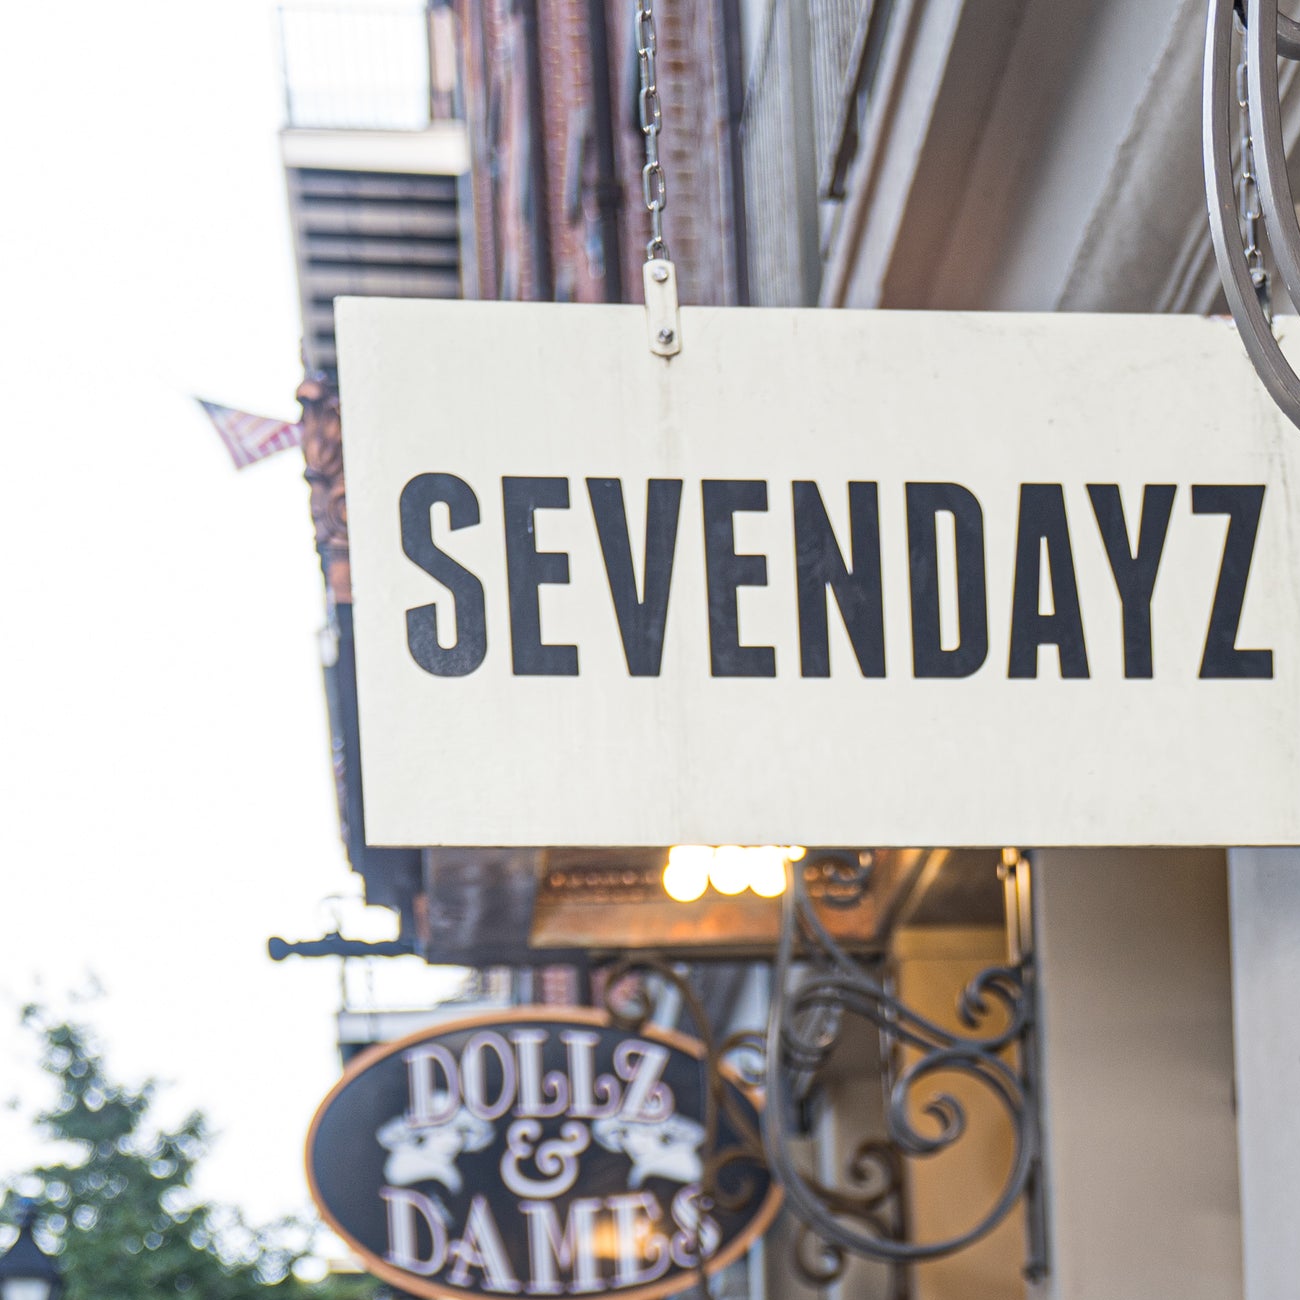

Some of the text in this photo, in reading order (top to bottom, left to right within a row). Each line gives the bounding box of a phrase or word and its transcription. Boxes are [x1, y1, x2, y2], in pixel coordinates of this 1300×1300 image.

[398, 470, 1275, 681] SEVENDAYZ
[404, 1028, 676, 1129] DOLLZ
[500, 1118, 591, 1199] &
[379, 1184, 721, 1295] DAMES
